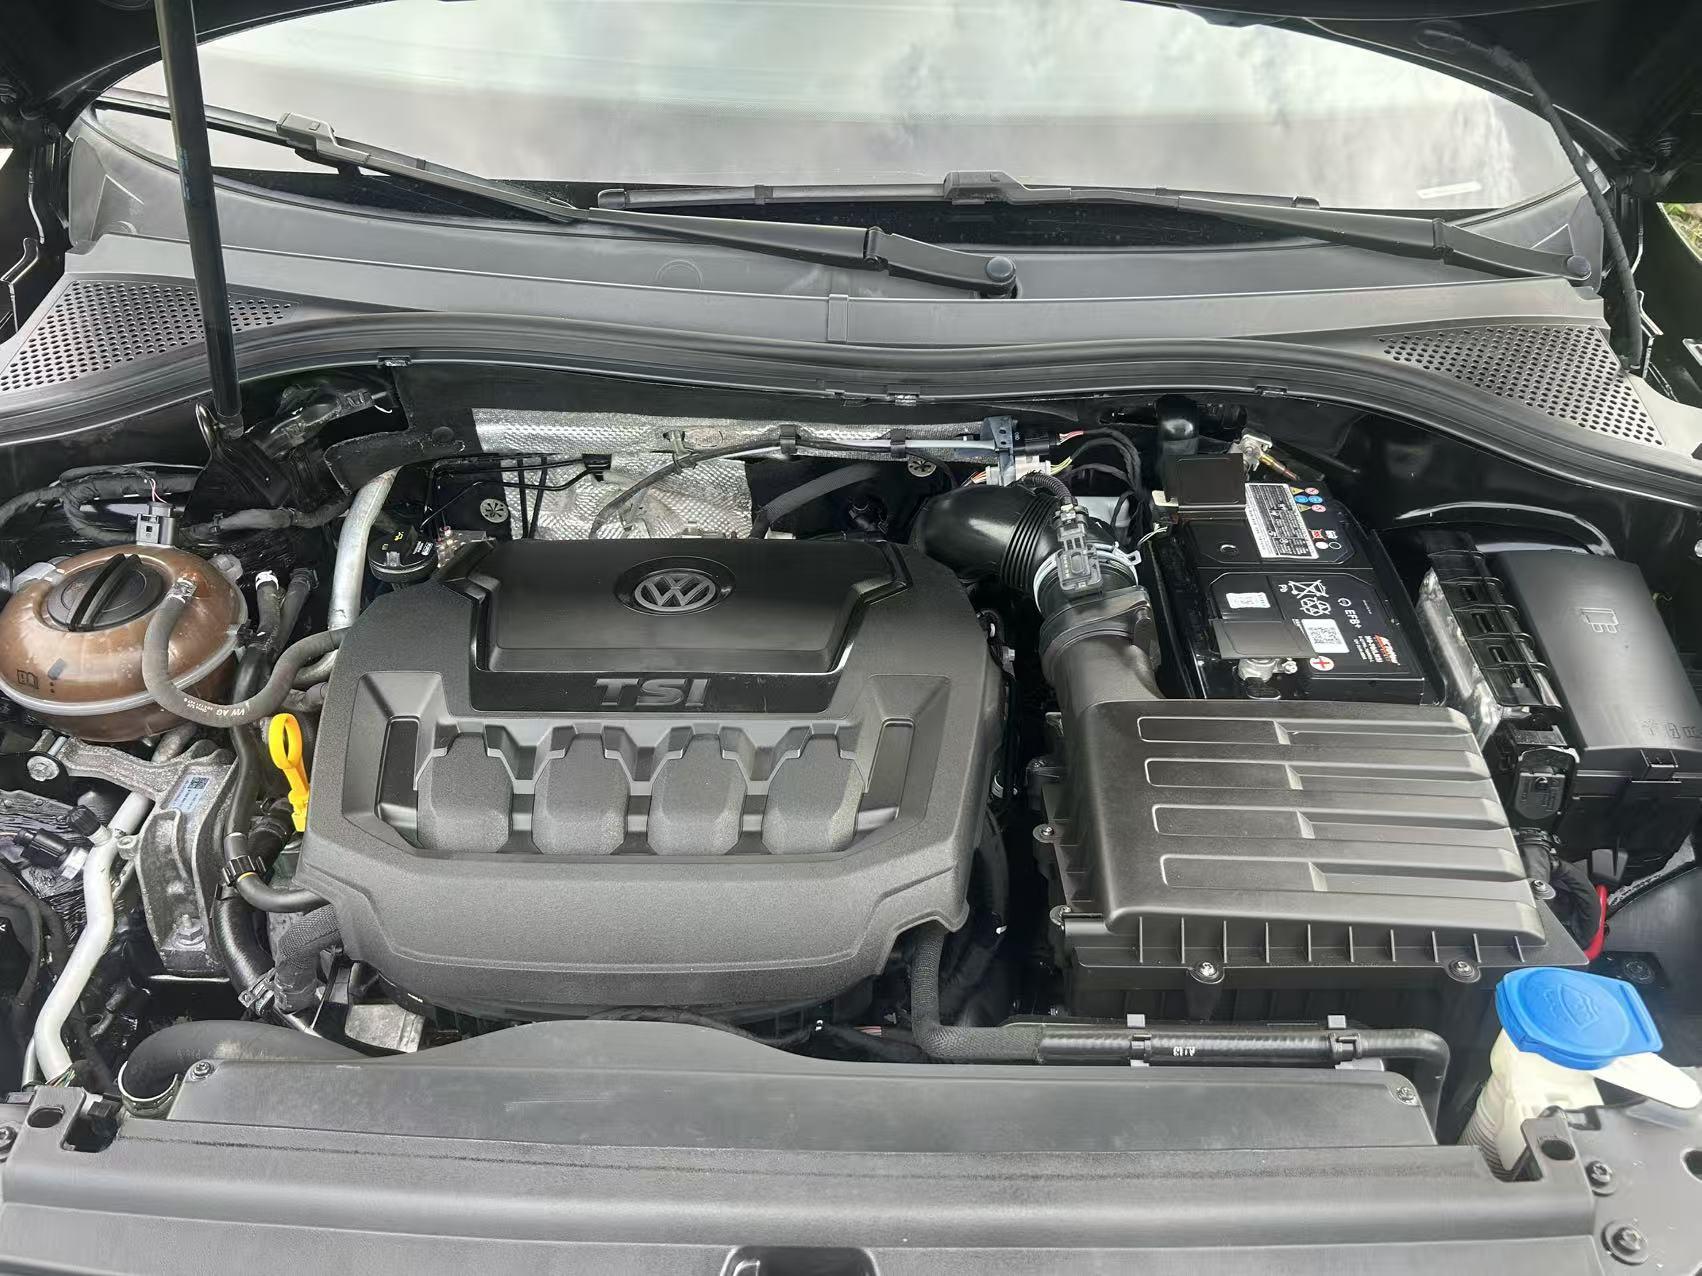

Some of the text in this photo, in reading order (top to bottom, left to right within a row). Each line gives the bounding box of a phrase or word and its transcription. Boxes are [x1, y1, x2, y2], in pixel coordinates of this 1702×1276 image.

[1344, 609, 1362, 629] EFB+
[595, 677, 711, 707] TSI
[231, 708, 245, 716] VW
